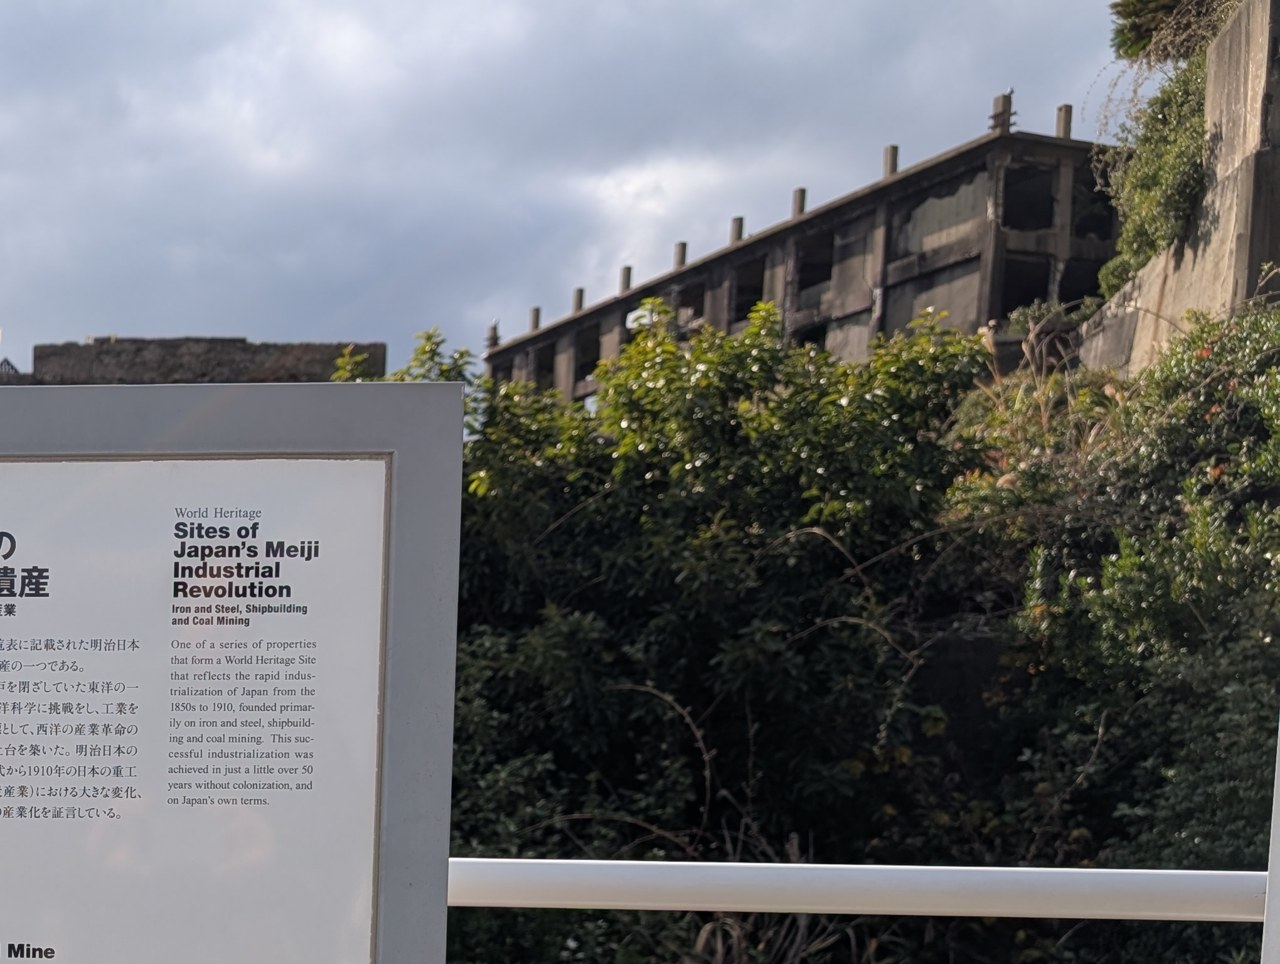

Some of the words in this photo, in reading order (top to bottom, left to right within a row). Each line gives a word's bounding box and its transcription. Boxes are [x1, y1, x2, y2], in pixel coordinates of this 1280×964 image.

[175, 508, 208, 518] World
[214, 507, 261, 521] Heritage
[174, 522, 230, 539] Sites
[237, 522, 259, 539] of
[174, 541, 258, 562] Japan’s
[265, 541, 319, 561] Meiji
[174, 562, 280, 578] Industrial
[173, 581, 291, 598] Revolution
[172, 604, 191, 613] Iron
[194, 605, 212, 613] and
[215, 604, 242, 615] Steel,
[246, 604, 307, 615] Shipbuilding
[172, 616, 189, 625] and
[193, 616, 213, 625] Coal
[217, 616, 250, 627] Mining
[171, 640, 191, 649] One
[196, 640, 207, 649] of
[220, 640, 247, 649] series
[252, 639, 263, 648] of
[266, 639, 316, 651] properties
[171, 655, 188, 664] that
[192, 655, 213, 664] form
[225, 656, 252, 664] World
[256, 655, 295, 667] Heritage
[299, 655, 316, 664] Site
[171, 671, 189, 680] that
[194, 671, 230, 680] reflects
[235, 671, 250, 680] the
[255, 671, 280, 682] rapid
[285, 671, 316, 680] indus-
[170, 687, 222, 696] trialization
[227, 687, 238, 696] of
[241, 687, 268, 698] Japan
[273, 687, 296, 696] from
[301, 687, 315, 696] the
[171, 703, 196, 711] 1850s
[213, 703, 235, 713] 1910,
[239, 702, 276, 711] founded
[280, 702, 315, 714] primar-
[170, 718, 181, 729] ily
[199, 718, 217, 727] iron
[221, 718, 237, 727] and
[240, 718, 264, 728] steel,
[268, 718, 314, 729] shipbuild-
[169, 733, 184, 745] ing
[187, 734, 203, 743] and
[206, 734, 225, 743] coal
[229, 734, 264, 745] mining.
[271, 734, 291, 743] This
[169, 749, 202, 758] cessful
[208, 749, 289, 758] industrialization
[168, 765, 208, 773] achieved
[212, 765, 221, 774] in
[223, 765, 241, 776] just
[254, 765, 274, 774] little
[302, 765, 313, 774] 50
[168, 783, 192, 791] years
[195, 780, 230, 789] without
[233, 780, 292, 791] colonization,
[296, 781, 312, 790] and
[182, 796, 214, 807] Japan’s
[8, 944, 55, 959] Mine
